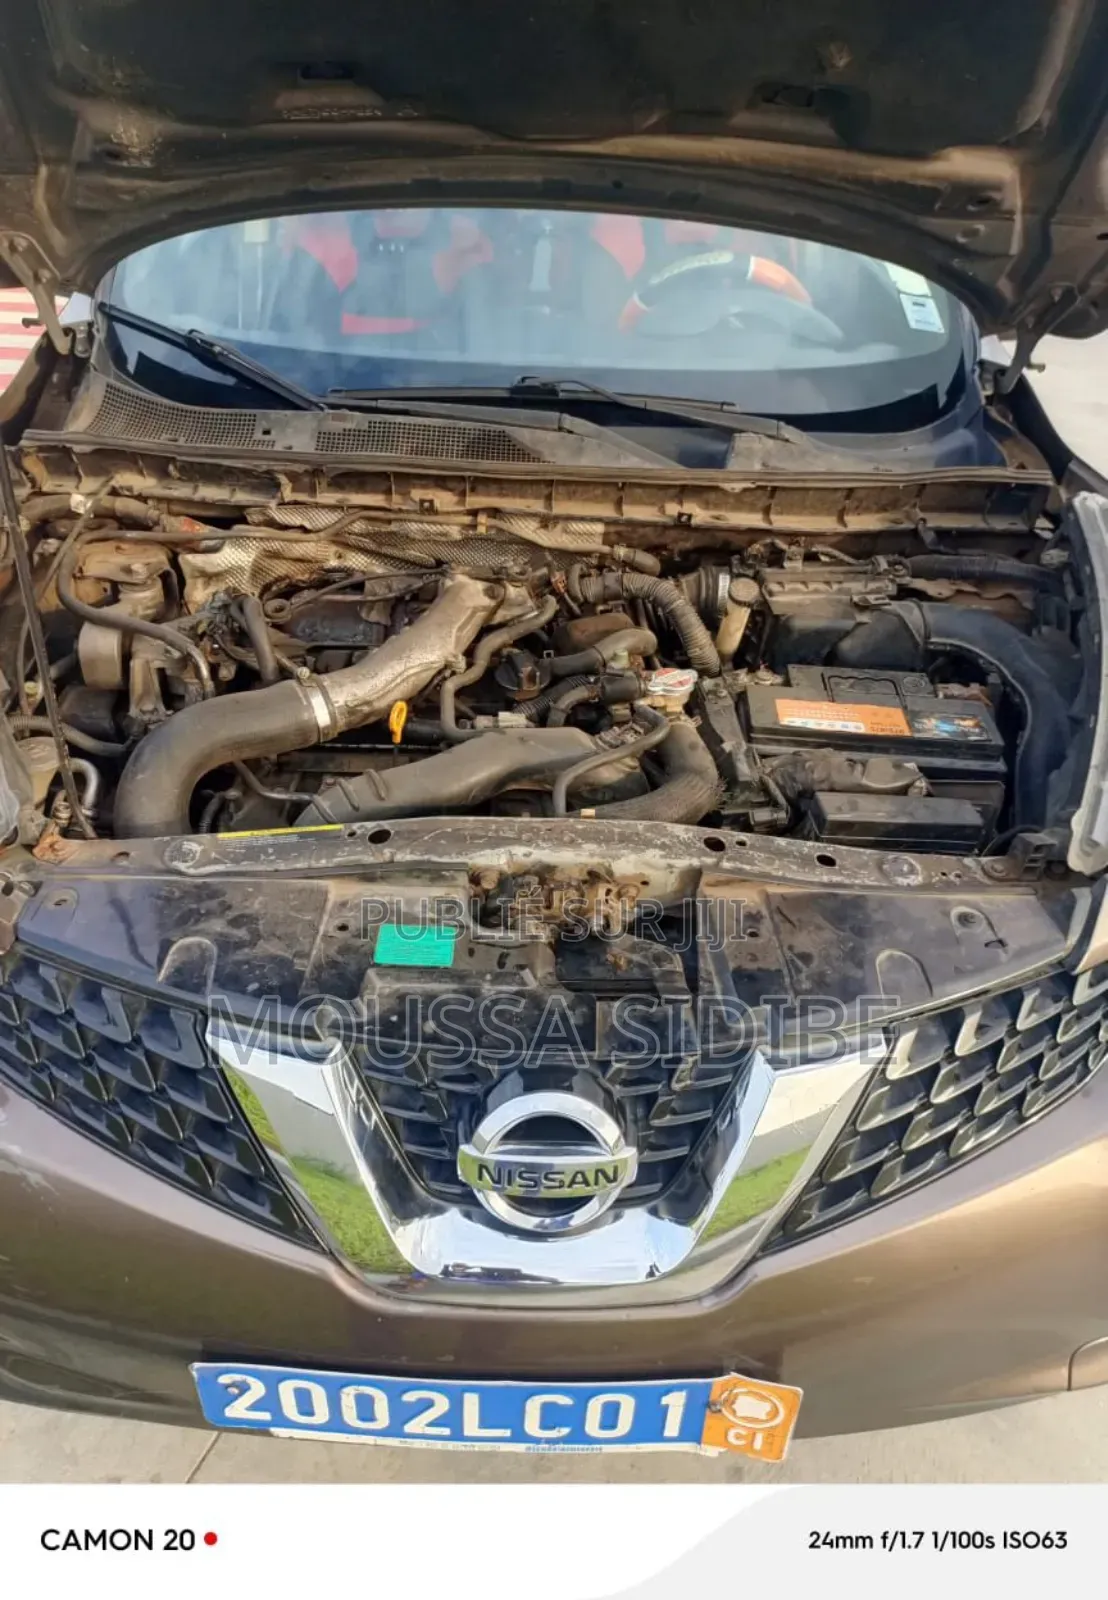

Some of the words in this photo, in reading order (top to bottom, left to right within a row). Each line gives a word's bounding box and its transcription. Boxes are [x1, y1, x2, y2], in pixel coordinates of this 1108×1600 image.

[477, 1163, 619, 1190] NISSAN
[216, 1372, 688, 1440] 2002LC01
[727, 1427, 764, 1451] CI
